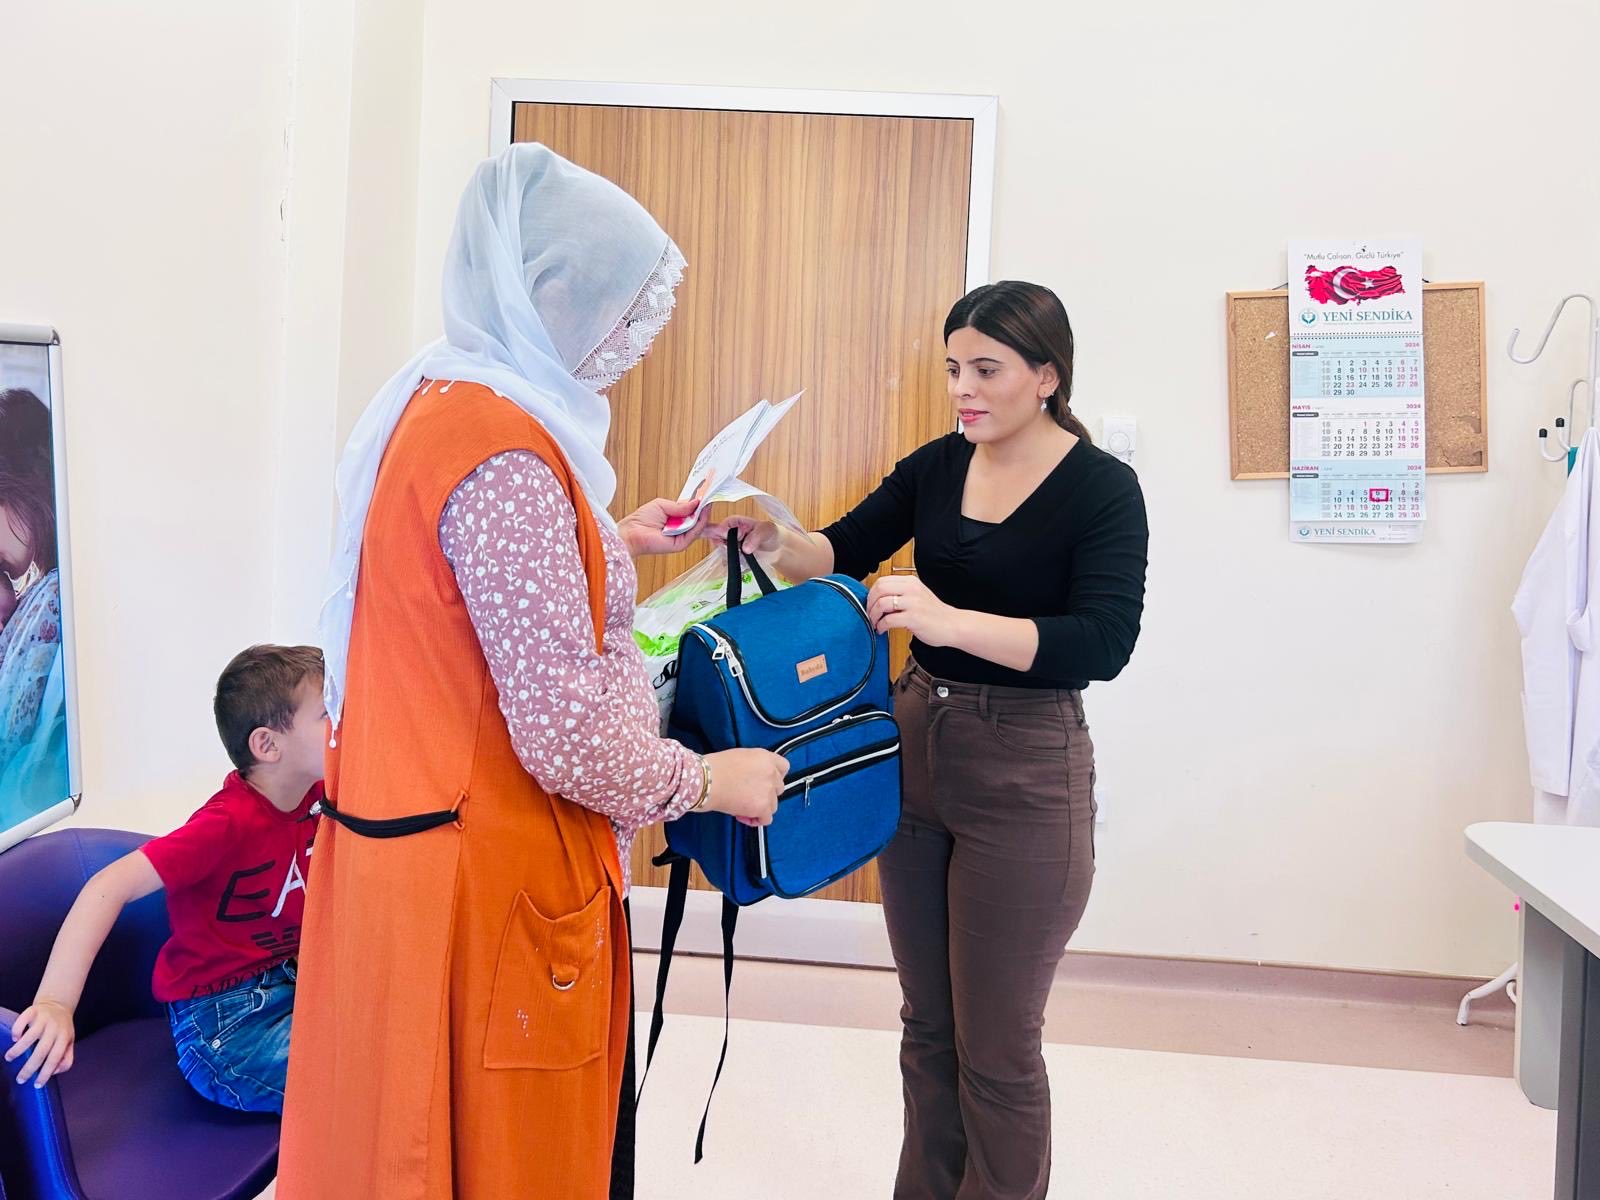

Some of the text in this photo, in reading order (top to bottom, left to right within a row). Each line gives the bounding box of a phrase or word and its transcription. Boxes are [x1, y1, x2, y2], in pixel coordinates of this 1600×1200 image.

[1323, 308, 1413, 321] YENİ SENDİKA
[216, 847, 313, 923] EA
